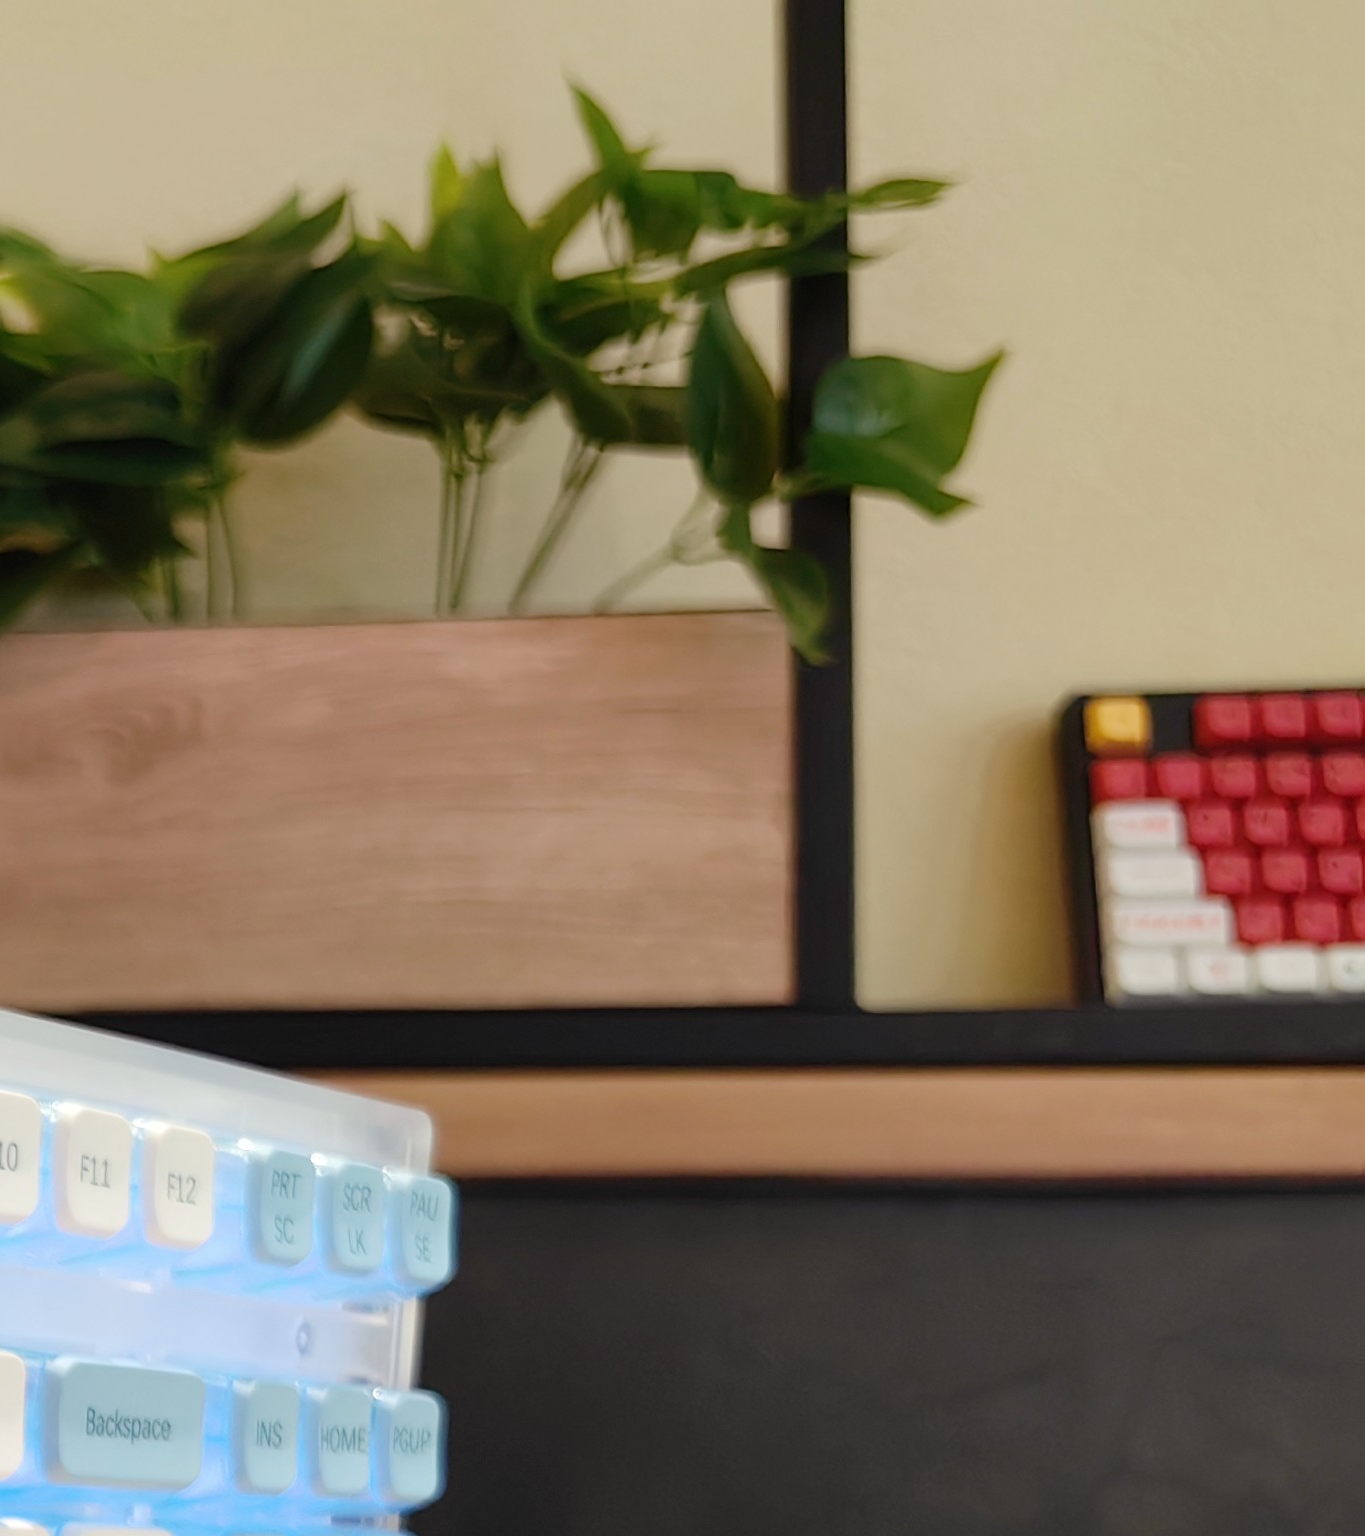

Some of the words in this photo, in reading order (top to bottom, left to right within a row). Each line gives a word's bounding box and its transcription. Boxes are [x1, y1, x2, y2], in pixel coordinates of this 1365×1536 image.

[79, 1154, 111, 1189] F11
[271, 1169, 302, 1198] PRT
[166, 1171, 198, 1206] F12
[343, 1183, 373, 1212] SCR
[410, 1190, 440, 1222] PAU
[274, 1214, 295, 1245] SC
[349, 1229, 367, 1255] LK
[85, 1406, 173, 1444] Backspace
[256, 1420, 284, 1449] INS
[320, 1424, 367, 1453] HOME
[392, 1426, 433, 1451] PGUP
